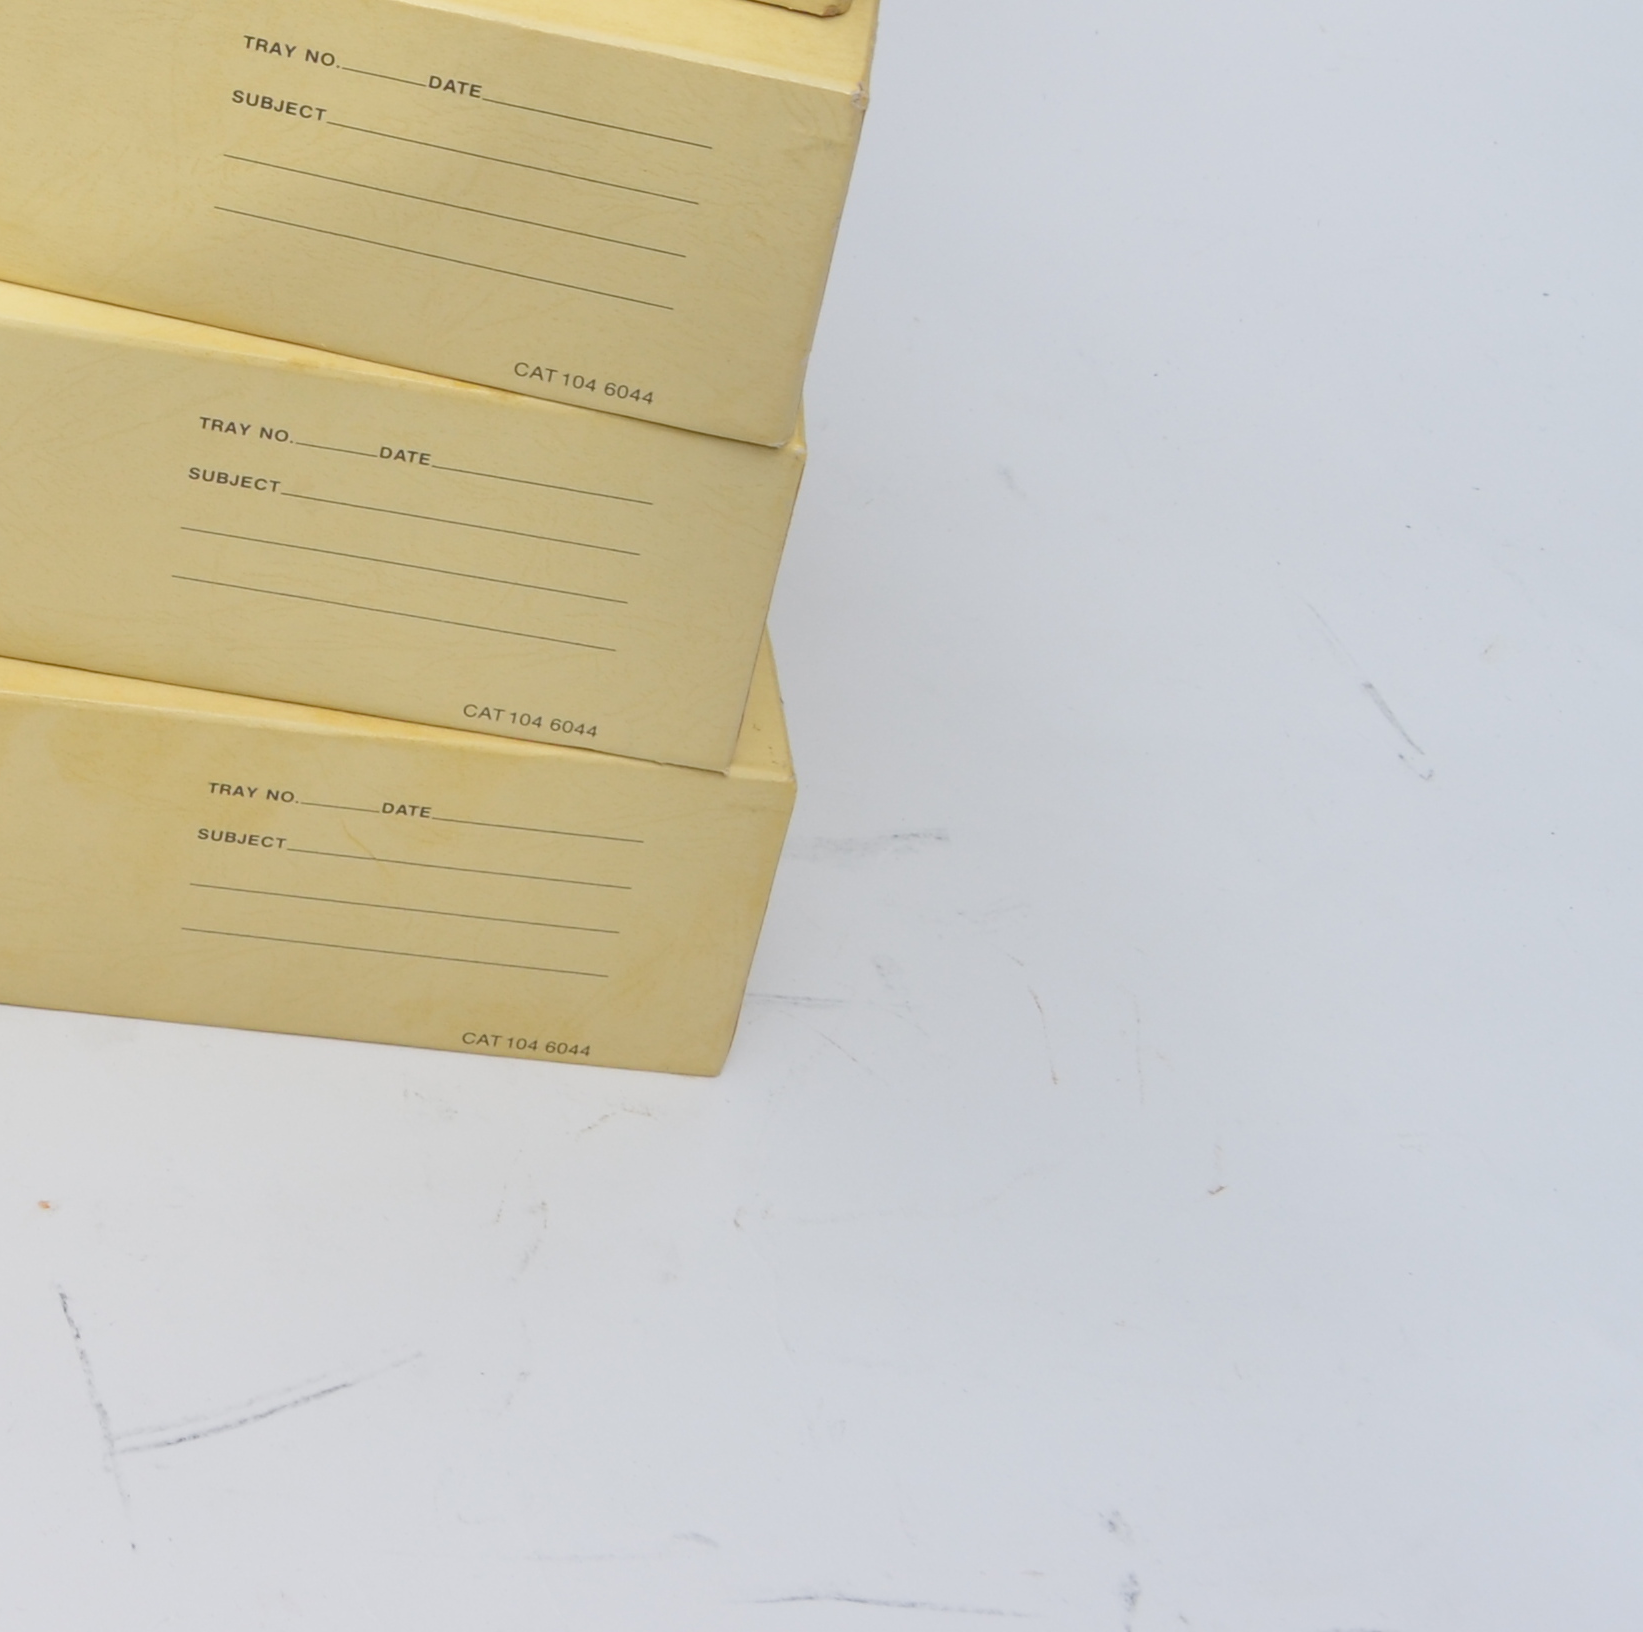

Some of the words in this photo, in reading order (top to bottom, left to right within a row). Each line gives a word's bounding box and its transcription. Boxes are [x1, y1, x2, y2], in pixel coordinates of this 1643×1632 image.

[244, 35, 297, 59] TRAY
[305, 48, 341, 69] NO.
[428, 75, 483, 99] DATE
[231, 89, 328, 123] SUBJECT
[514, 362, 558, 384] CAT
[563, 372, 597, 393] 104
[605, 382, 655, 406] 6044
[199, 416, 251, 436] TRAY
[259, 426, 294, 445] NO.
[379, 445, 431, 467] DATE
[188, 466, 281, 494] SUBJECT
[463, 703, 506, 724] CAT
[509, 712, 542, 730] 104
[550, 717, 598, 738] 6044
[208, 782, 259, 800] TRAY
[266, 788, 299, 805] NO.
[382, 802, 432, 820] DATE
[197, 828, 288, 850] SUBJECT
[461, 1031, 503, 1049] CAT
[506, 1037, 538, 1052] 104
[545, 1041, 591, 1058] 6044
